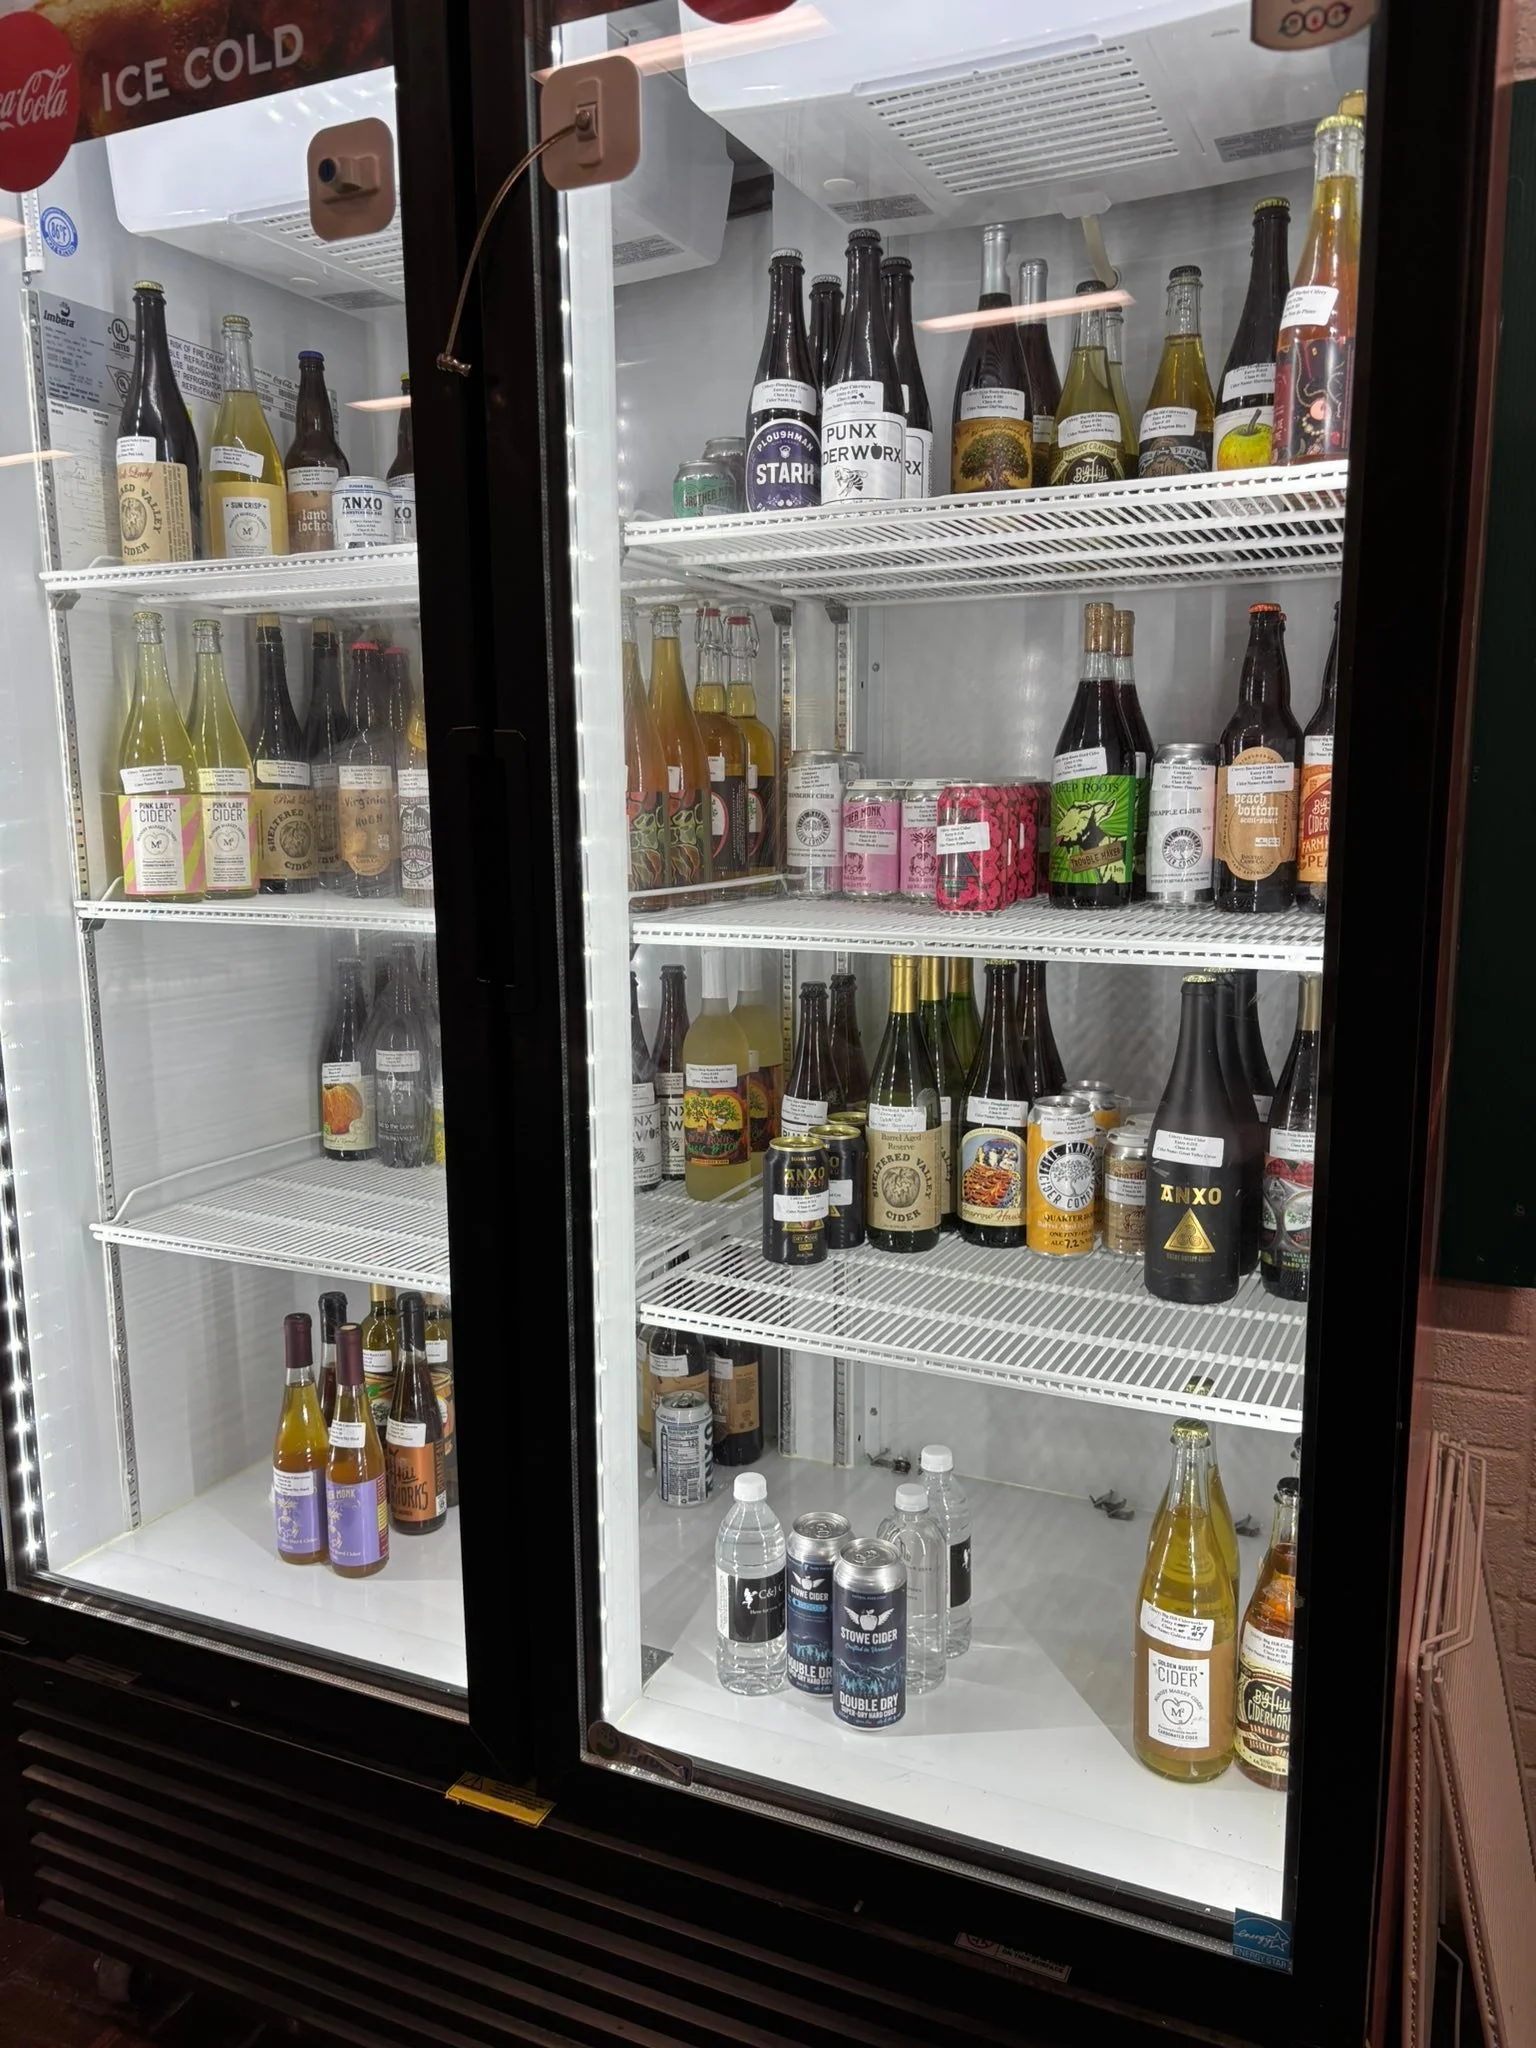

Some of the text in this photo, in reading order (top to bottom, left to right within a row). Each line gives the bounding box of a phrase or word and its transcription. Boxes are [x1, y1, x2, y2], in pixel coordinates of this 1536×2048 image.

[102, 24, 304, 112] ICE COLD
[43, 309, 75, 328] Imbera
[192, 347, 204, 358] FIRE
[184, 353, 224, 372] REFRIGERANT
[826, 423, 877, 443] PUNX
[756, 462, 815, 485] STARK
[1073, 455, 1109, 483] Big Hill
[342, 497, 382, 510] ANXO
[141, 488, 162, 535] VALLEY
[302, 509, 327, 520] land
[298, 520, 333, 532] locked
[124, 542, 150, 555] CIDER
[1055, 783, 1119, 794] DEEP ROOTS
[1234, 792, 1266, 806] peach
[861, 806, 881, 818] MONK
[1180, 807, 1201, 815] CIDER
[1238, 804, 1278, 816] bottom
[1312, 798, 1328, 816] Big
[139, 809, 173, 822] CIDER
[212, 809, 243, 821] CIDER
[268, 809, 304, 852] SHELTERED
[1072, 847, 1120, 867] TROUBLE MAKER
[284, 861, 312, 871] CIDER
[881, 1133, 921, 1142] Barrel Aged
[888, 1143, 915, 1151] Reserve
[784, 1166, 825, 1181] ANXO
[871, 1153, 932, 1200] SHELTERED VALLEY
[1039, 1176, 1062, 1205] CIDER
[1160, 1184, 1222, 1206] ANXO
[885, 1209, 922, 1222] CIDER
[1065, 1239, 1079, 1248] 7.2
[336, 1489, 356, 1499] MONK
[759, 1586, 776, 1599] C&J
[790, 1584, 829, 1601] STOWE CIDER
[1161, 1618, 1173, 1626] Entry
[1179, 1617, 1204, 1626] Ciderworks
[841, 1626, 898, 1645] STOWE CIDER
[1158, 1626, 1170, 1635] Name:
[1171, 1631, 1185, 1640] Golden
[845, 1643, 863, 1652] Crafted
[871, 1644, 892, 1652] Vermont
[1158, 1659, 1198, 1672] GOLDEN RUSSET
[1158, 1666, 1198, 1688] CIDER
[1168, 1688, 1191, 1698] MARKET
[1252, 1685, 1291, 1714] Big Hill
[840, 1690, 899, 1712] DOUBLE DRY
[841, 1705, 897, 1719] SUPER-DRY HARD CIDER
[1158, 1728, 1184, 1739] CARBONATED
[1250, 1724, 1273, 1737] BARREL
[1249, 1740, 1274, 1754] RESERVE
[1234, 1947, 1287, 1969] ENERGY STAR
